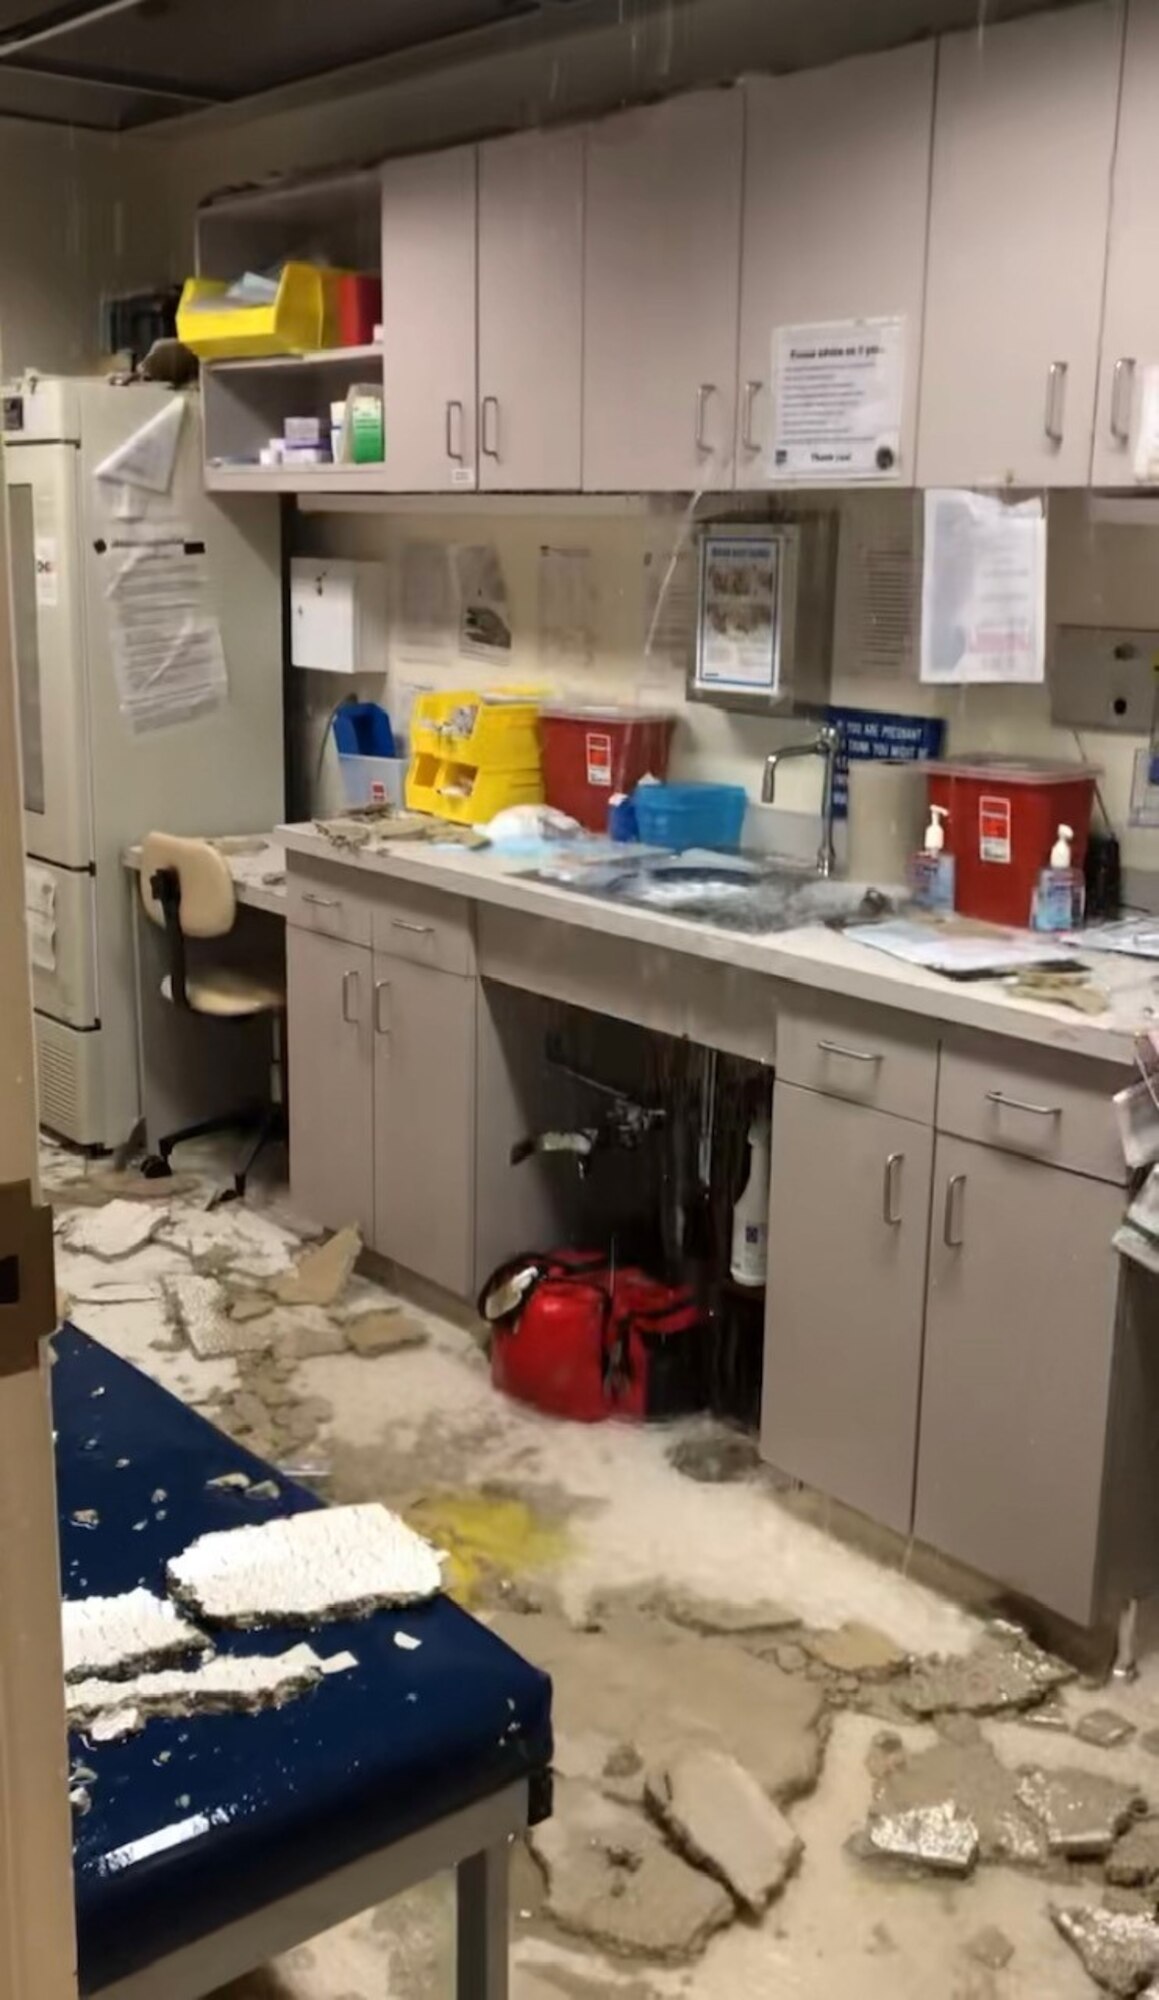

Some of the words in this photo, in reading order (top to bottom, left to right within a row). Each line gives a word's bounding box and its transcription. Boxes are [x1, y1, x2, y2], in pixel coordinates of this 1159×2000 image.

[847, 721, 862, 736] YOU
[864, 723, 879, 737] ARE
[881, 725, 922, 740] PREGNANT
[872, 742, 889, 756] YOU
